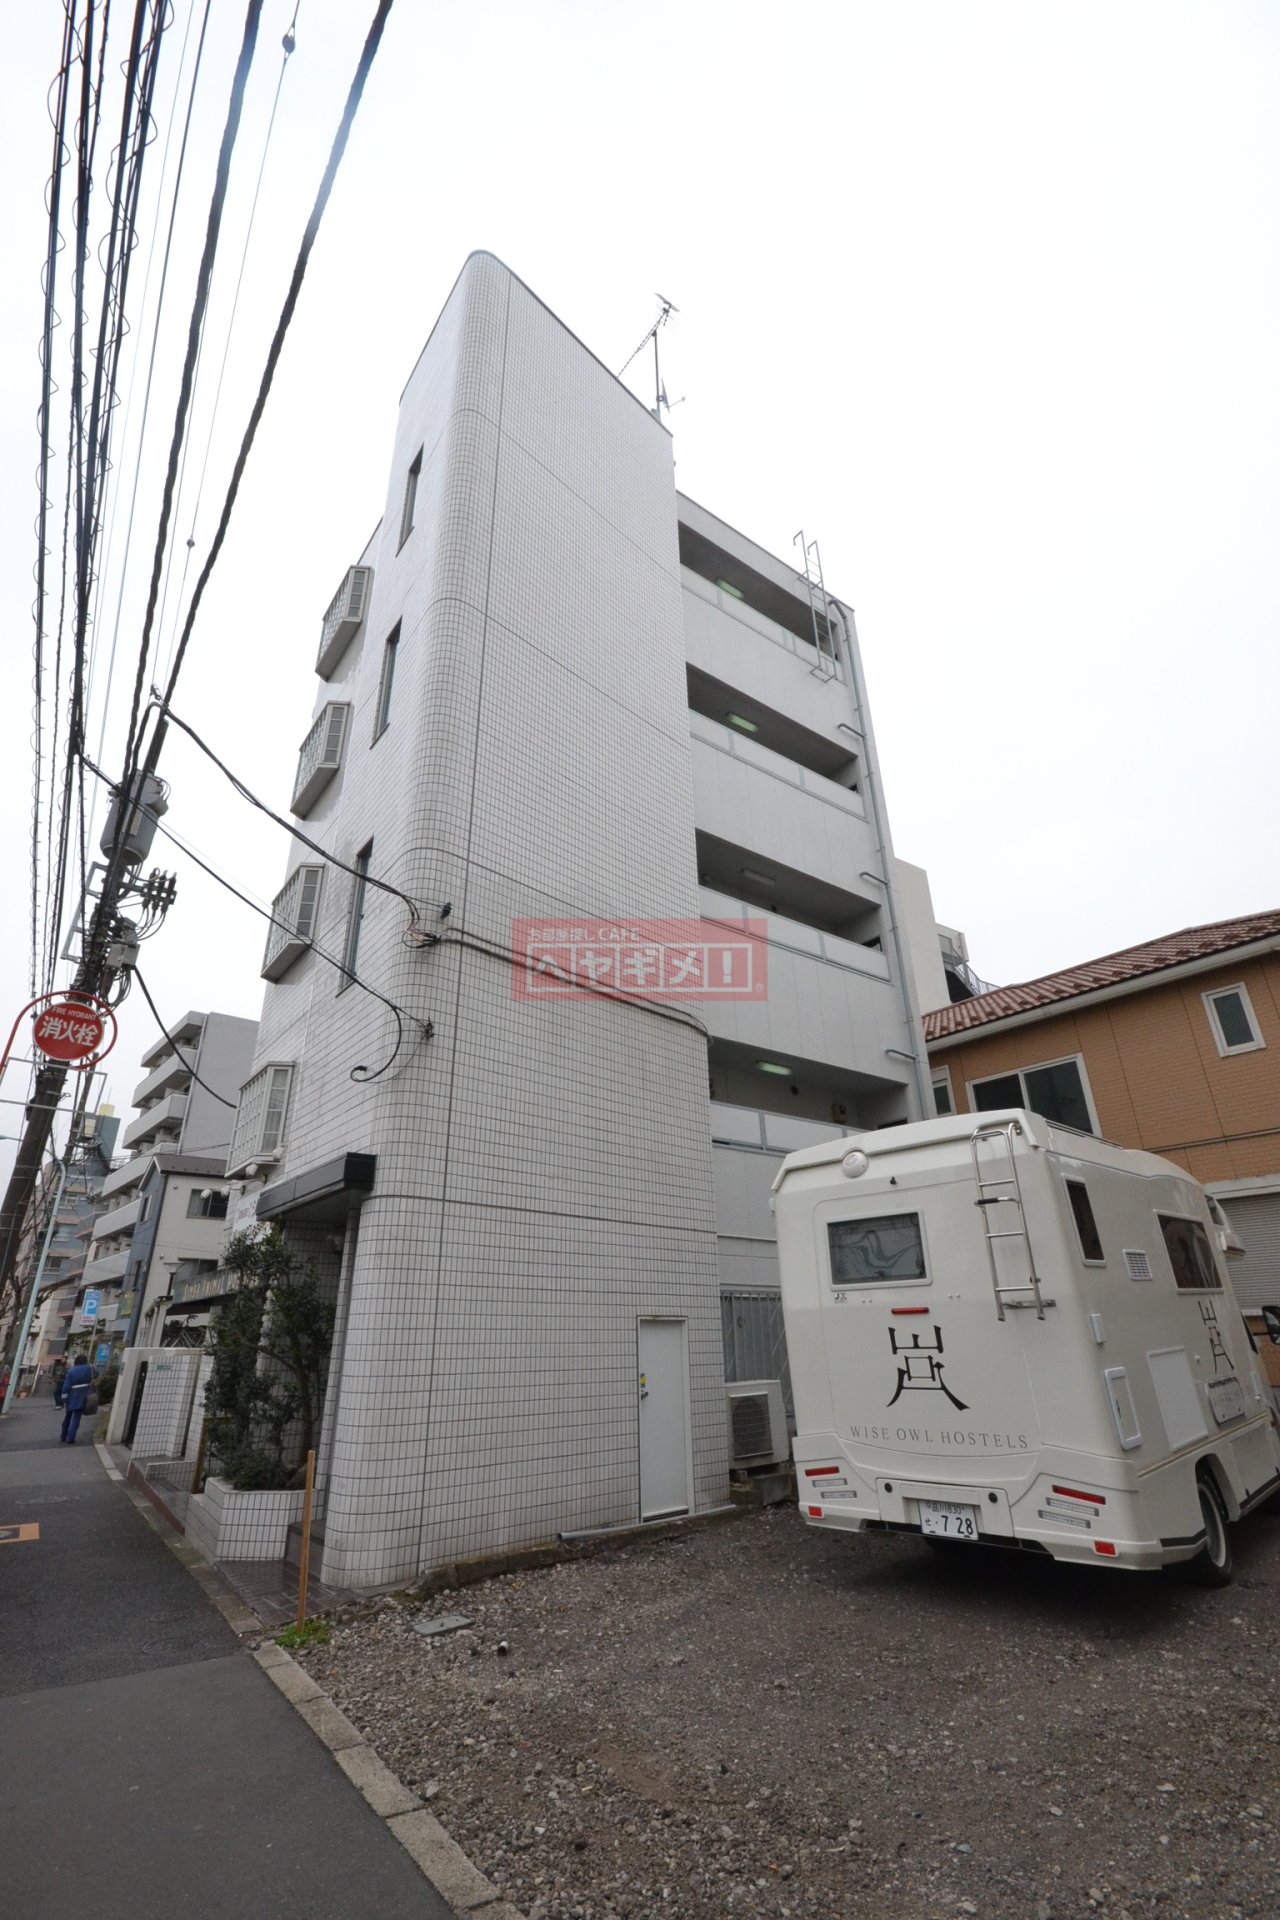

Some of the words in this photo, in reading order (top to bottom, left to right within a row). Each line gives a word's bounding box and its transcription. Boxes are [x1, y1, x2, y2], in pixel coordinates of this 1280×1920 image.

[52, 1006, 67, 1015] FIRE
[68, 1009, 97, 1020] HYDRANT
[39, 1016, 98, 1046] 消火栓
[84, 1299, 97, 1316] P
[850, 1425, 889, 1440] WISE
[896, 1428, 933, 1443] OWL
[941, 1431, 1028, 1449] HOSTELS
